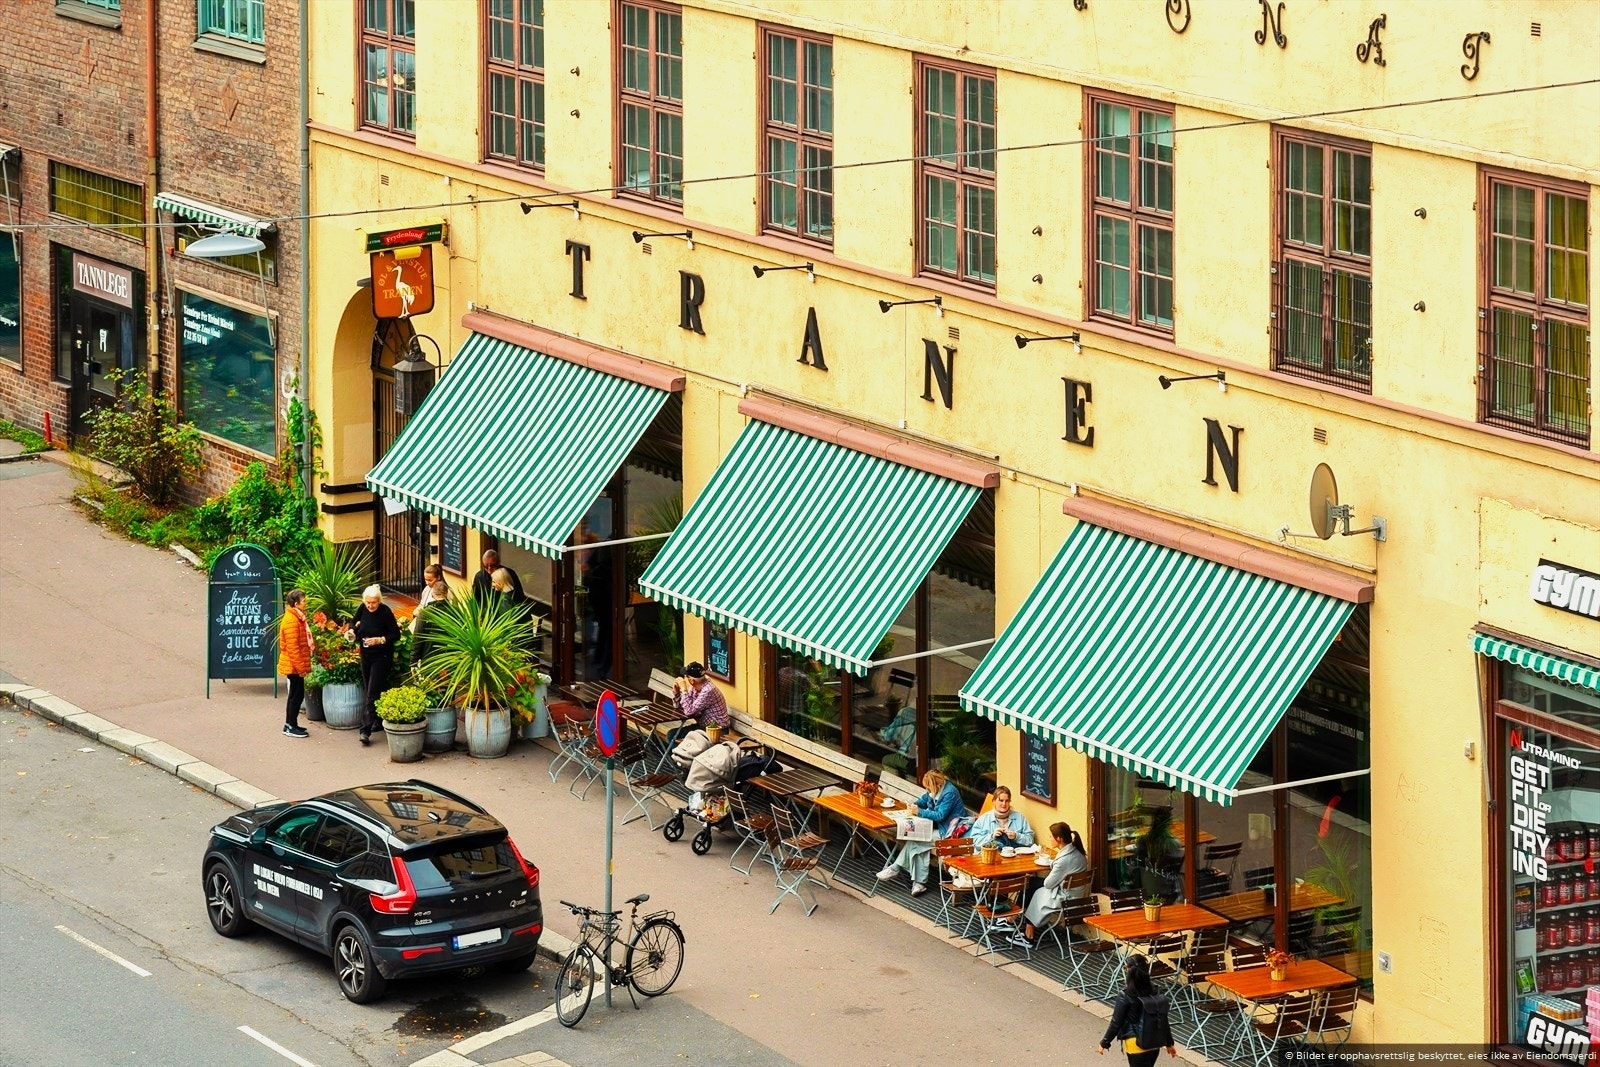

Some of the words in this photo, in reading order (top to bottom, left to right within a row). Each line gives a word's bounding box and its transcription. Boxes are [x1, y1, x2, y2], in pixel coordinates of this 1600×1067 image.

[386, 231, 423, 243] Frydenlund
[77, 262, 128, 299] TANNLEGE
[383, 285, 423, 299] TRANEN
[565, 239, 1245, 493] TRANEN
[226, 590, 259, 605] brød
[1529, 565, 1600, 617] GYM
[219, 625, 267, 637] sandwiches
[225, 615, 261, 625] KAFFE
[221, 651, 243, 664] take
[244, 654, 264, 665] away
[227, 636, 259, 649] JUICE
[1510, 729, 1581, 770] NUTRAMINO
[1510, 755, 1550, 787] GET
[1512, 778, 1542, 809] FIT
[1538, 802, 1552, 813] OR
[1513, 802, 1546, 834] DIE
[1510, 824, 1550, 858] TRY
[1512, 849, 1548, 882] ING
[450, 889, 503, 904] VOLVO
